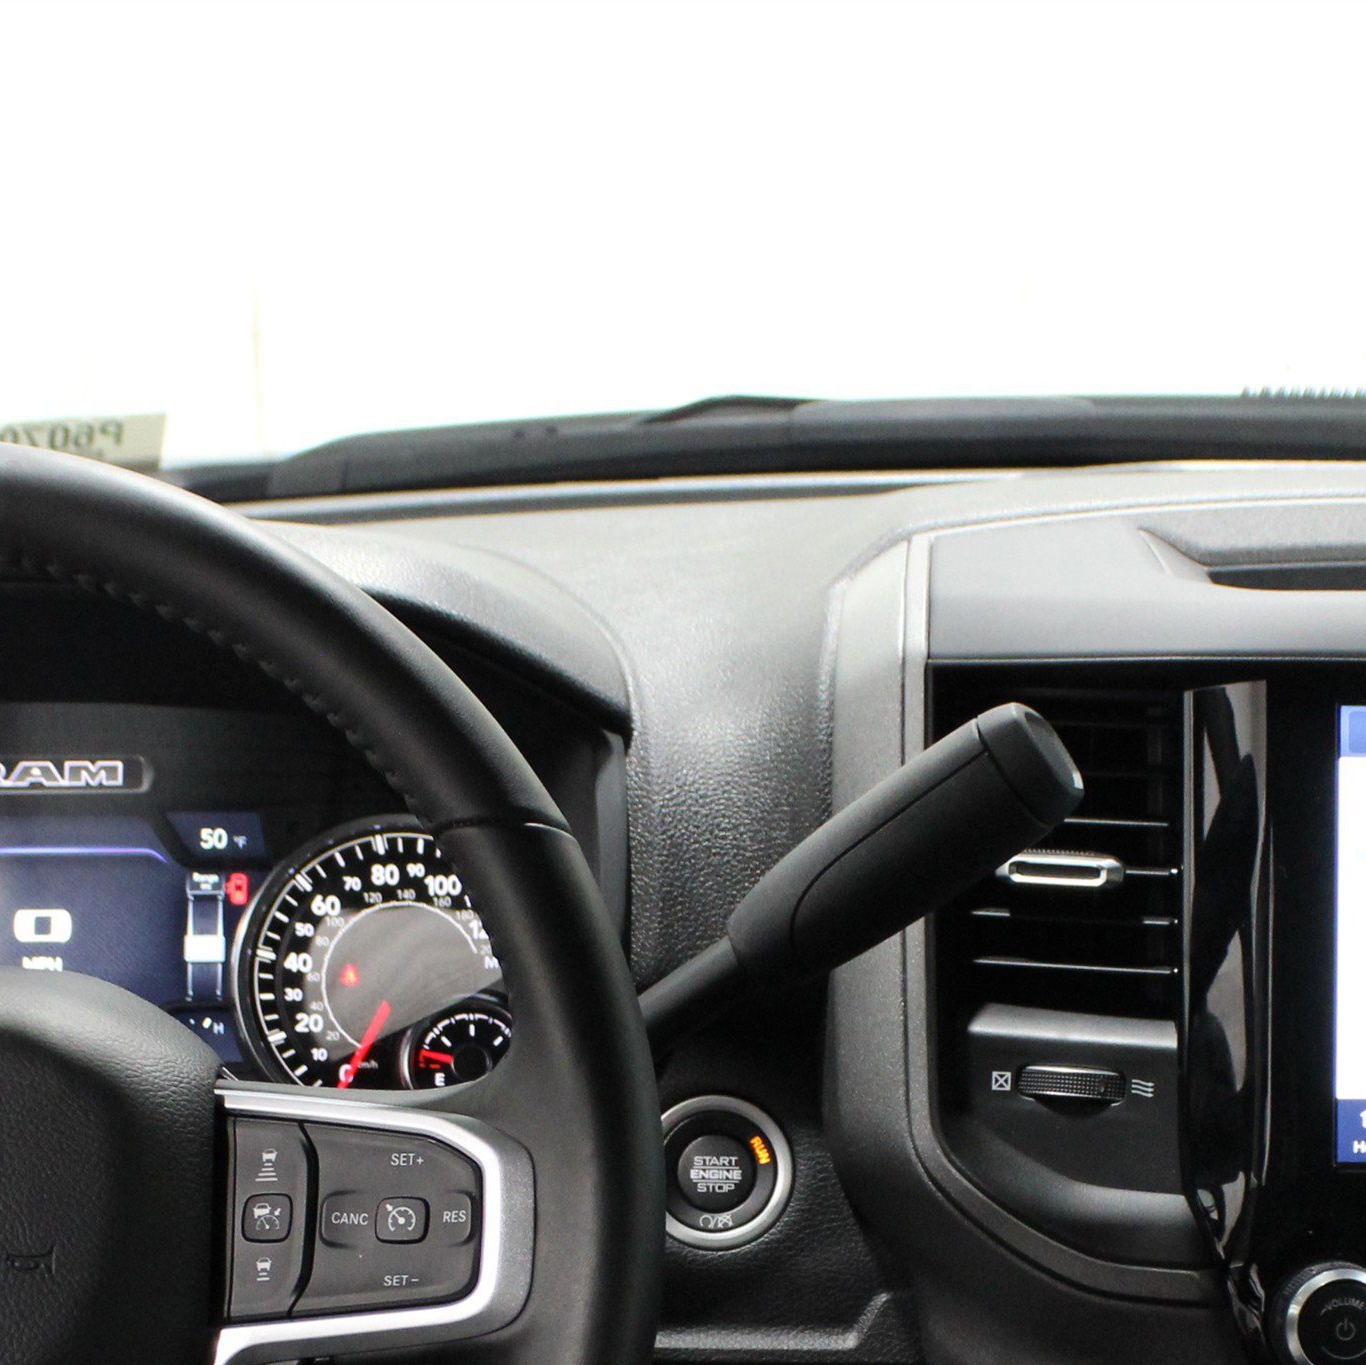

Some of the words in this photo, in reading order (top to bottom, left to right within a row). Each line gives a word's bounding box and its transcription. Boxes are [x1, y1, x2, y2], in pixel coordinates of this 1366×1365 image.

[199, 827, 228, 850] 50
[371, 863, 401, 886] 80
[406, 863, 426, 878] 90
[342, 876, 362, 892] 70
[424, 874, 462, 897] 100
[310, 894, 342, 917] 60
[13, 908, 72, 943] 0
[294, 922, 315, 938] 50
[283, 951, 314, 974] 40
[283, 987, 304, 1002] 30
[294, 1011, 325, 1034] 20
[310, 1047, 329, 1062] 10
[435, 1072, 446, 1087] E
[749, 1135, 772, 1166] RUN
[693, 1156, 738, 1166] START
[689, 1169, 743, 1181] ENGINE
[696, 1183, 735, 1193] STOP
[331, 1212, 369, 1226] CANC
[442, 1210, 467, 1224] RES
